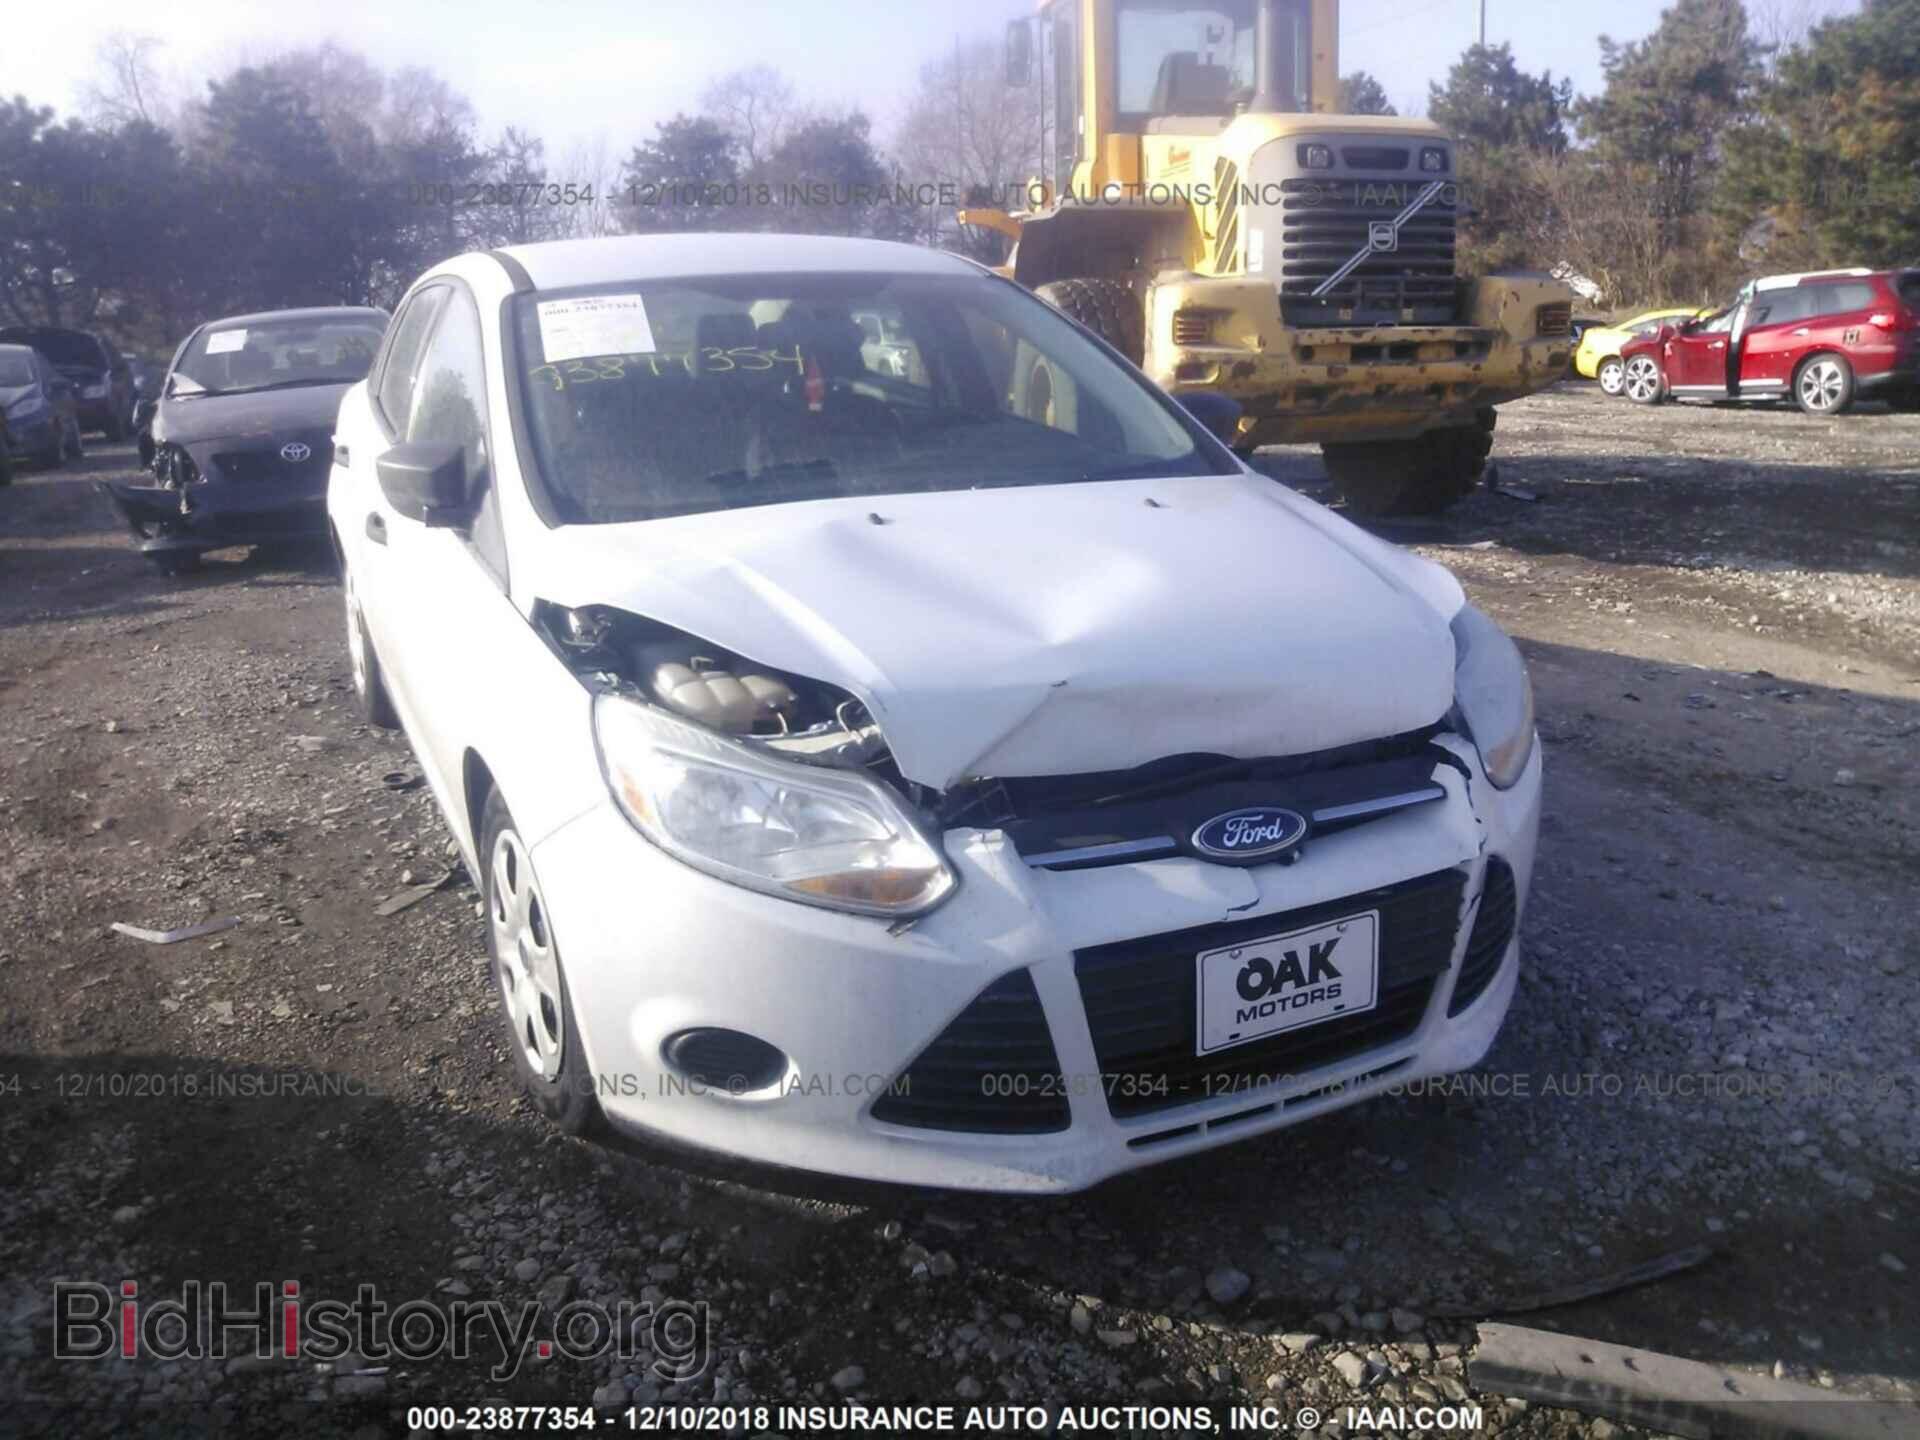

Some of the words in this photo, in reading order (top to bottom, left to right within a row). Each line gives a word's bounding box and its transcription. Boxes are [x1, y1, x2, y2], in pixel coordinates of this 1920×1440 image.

[1223, 814, 1284, 848] Ford
[1236, 937, 1343, 1002] OAK
[1235, 983, 1342, 1024] MOTORS
